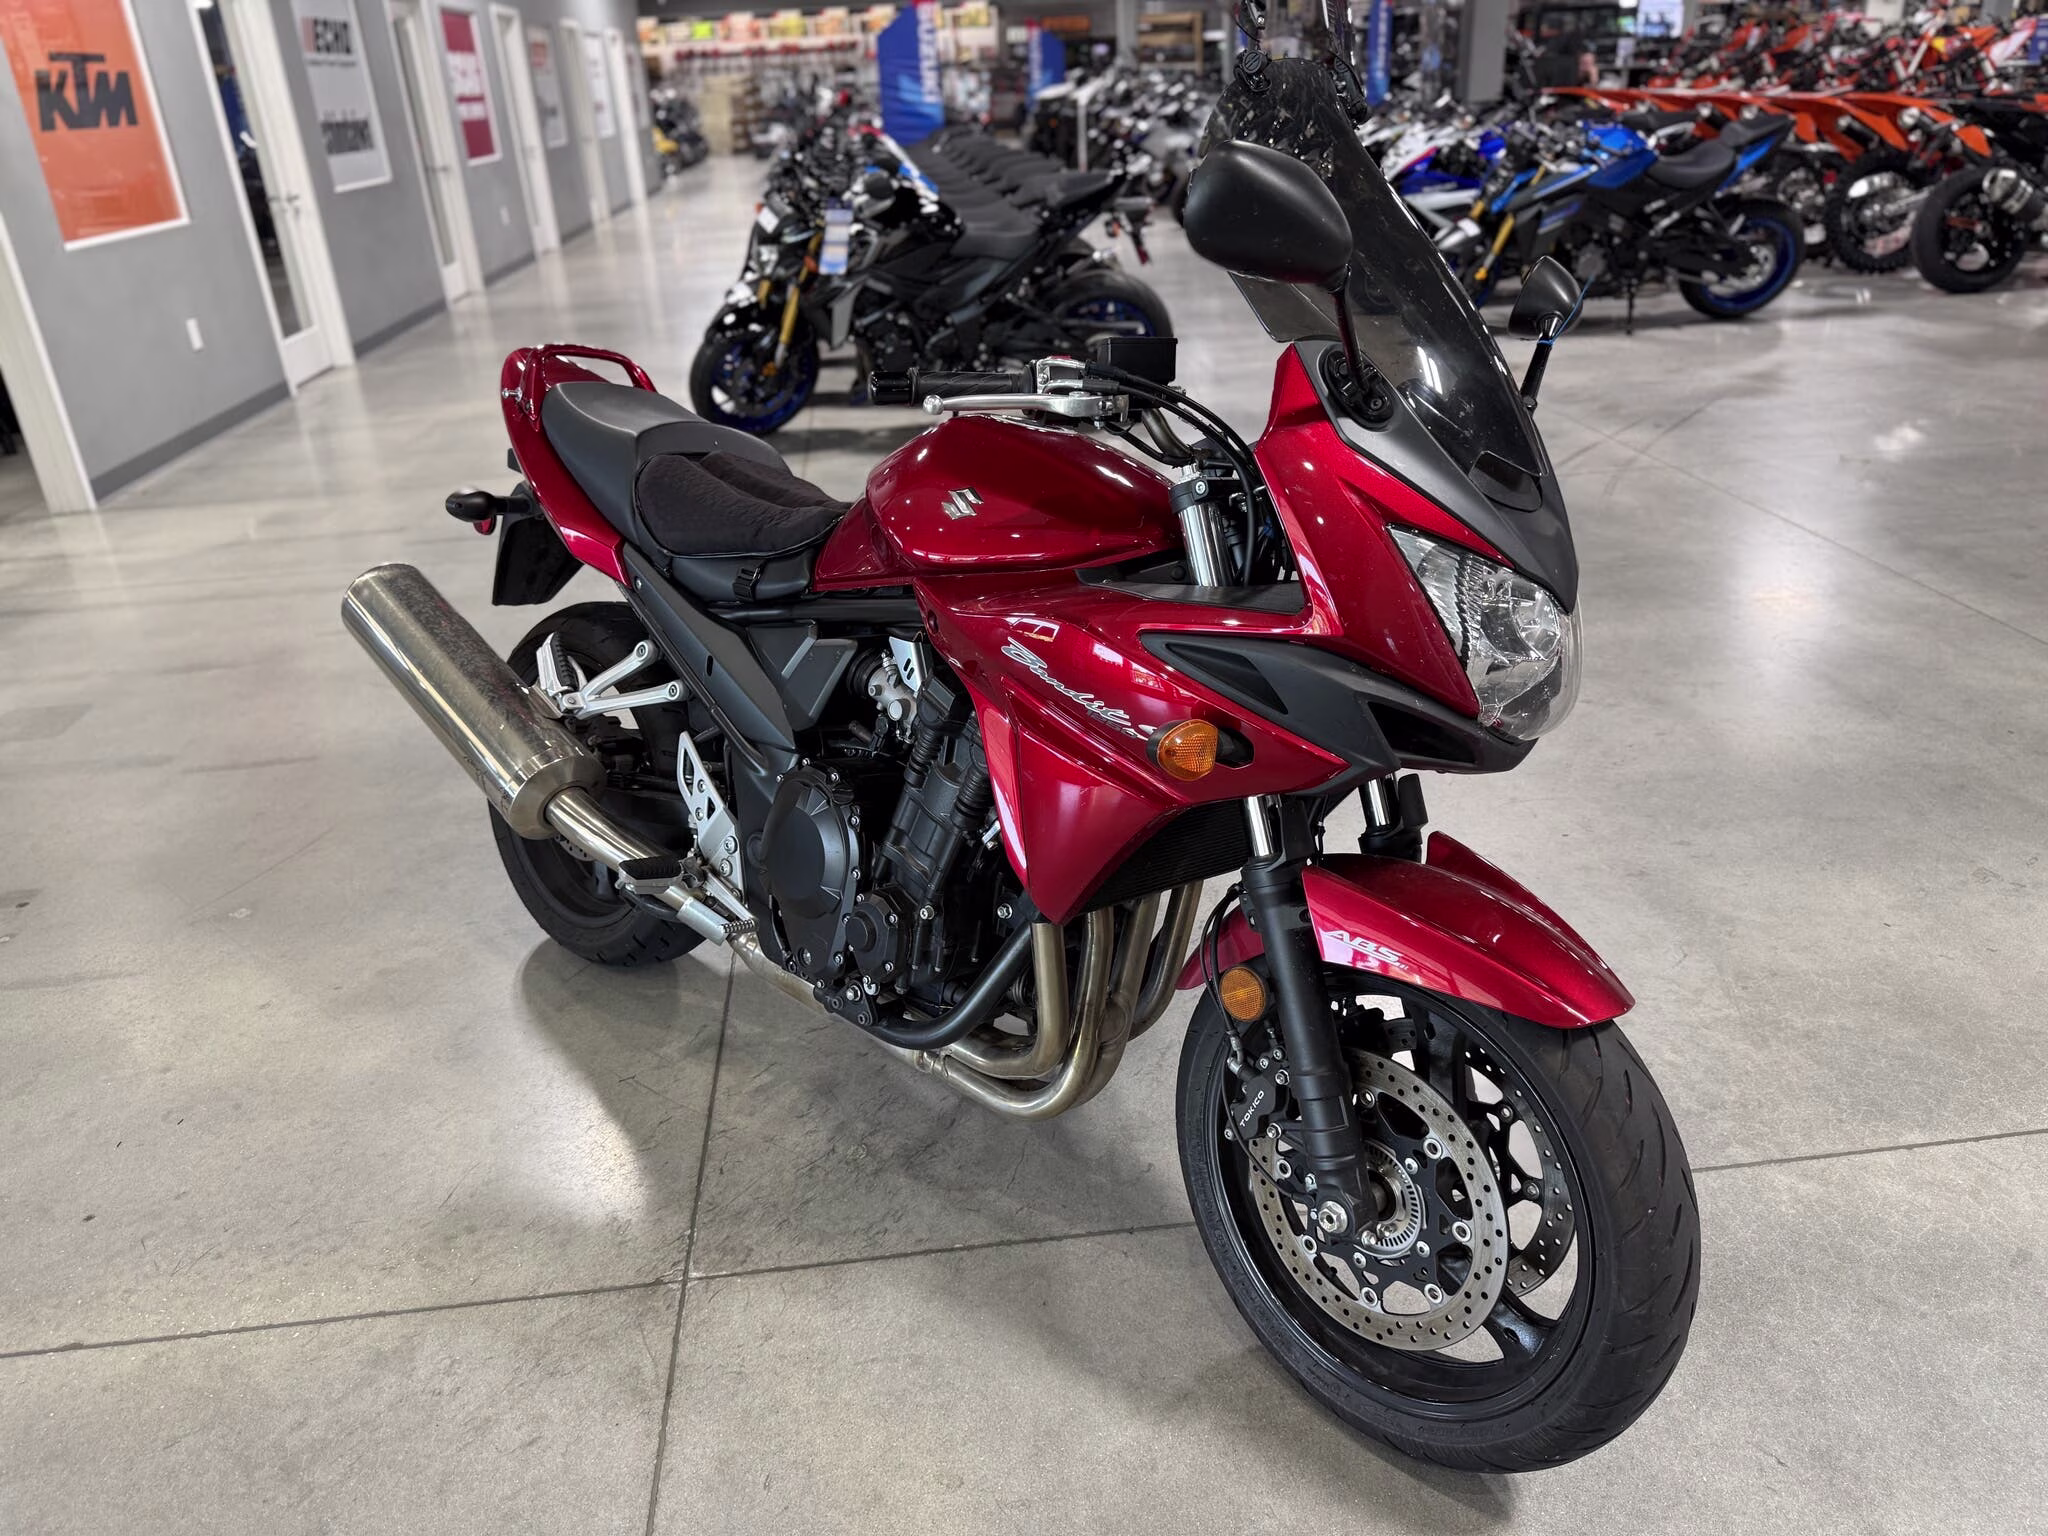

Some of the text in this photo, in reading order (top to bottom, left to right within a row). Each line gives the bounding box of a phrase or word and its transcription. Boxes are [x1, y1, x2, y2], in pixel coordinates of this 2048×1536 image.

[34, 52, 139, 132] KTM
[1001, 636, 1132, 727] Bandit
[1318, 927, 1405, 964] ABS
[1239, 1089, 1265, 1128] TOKICO
